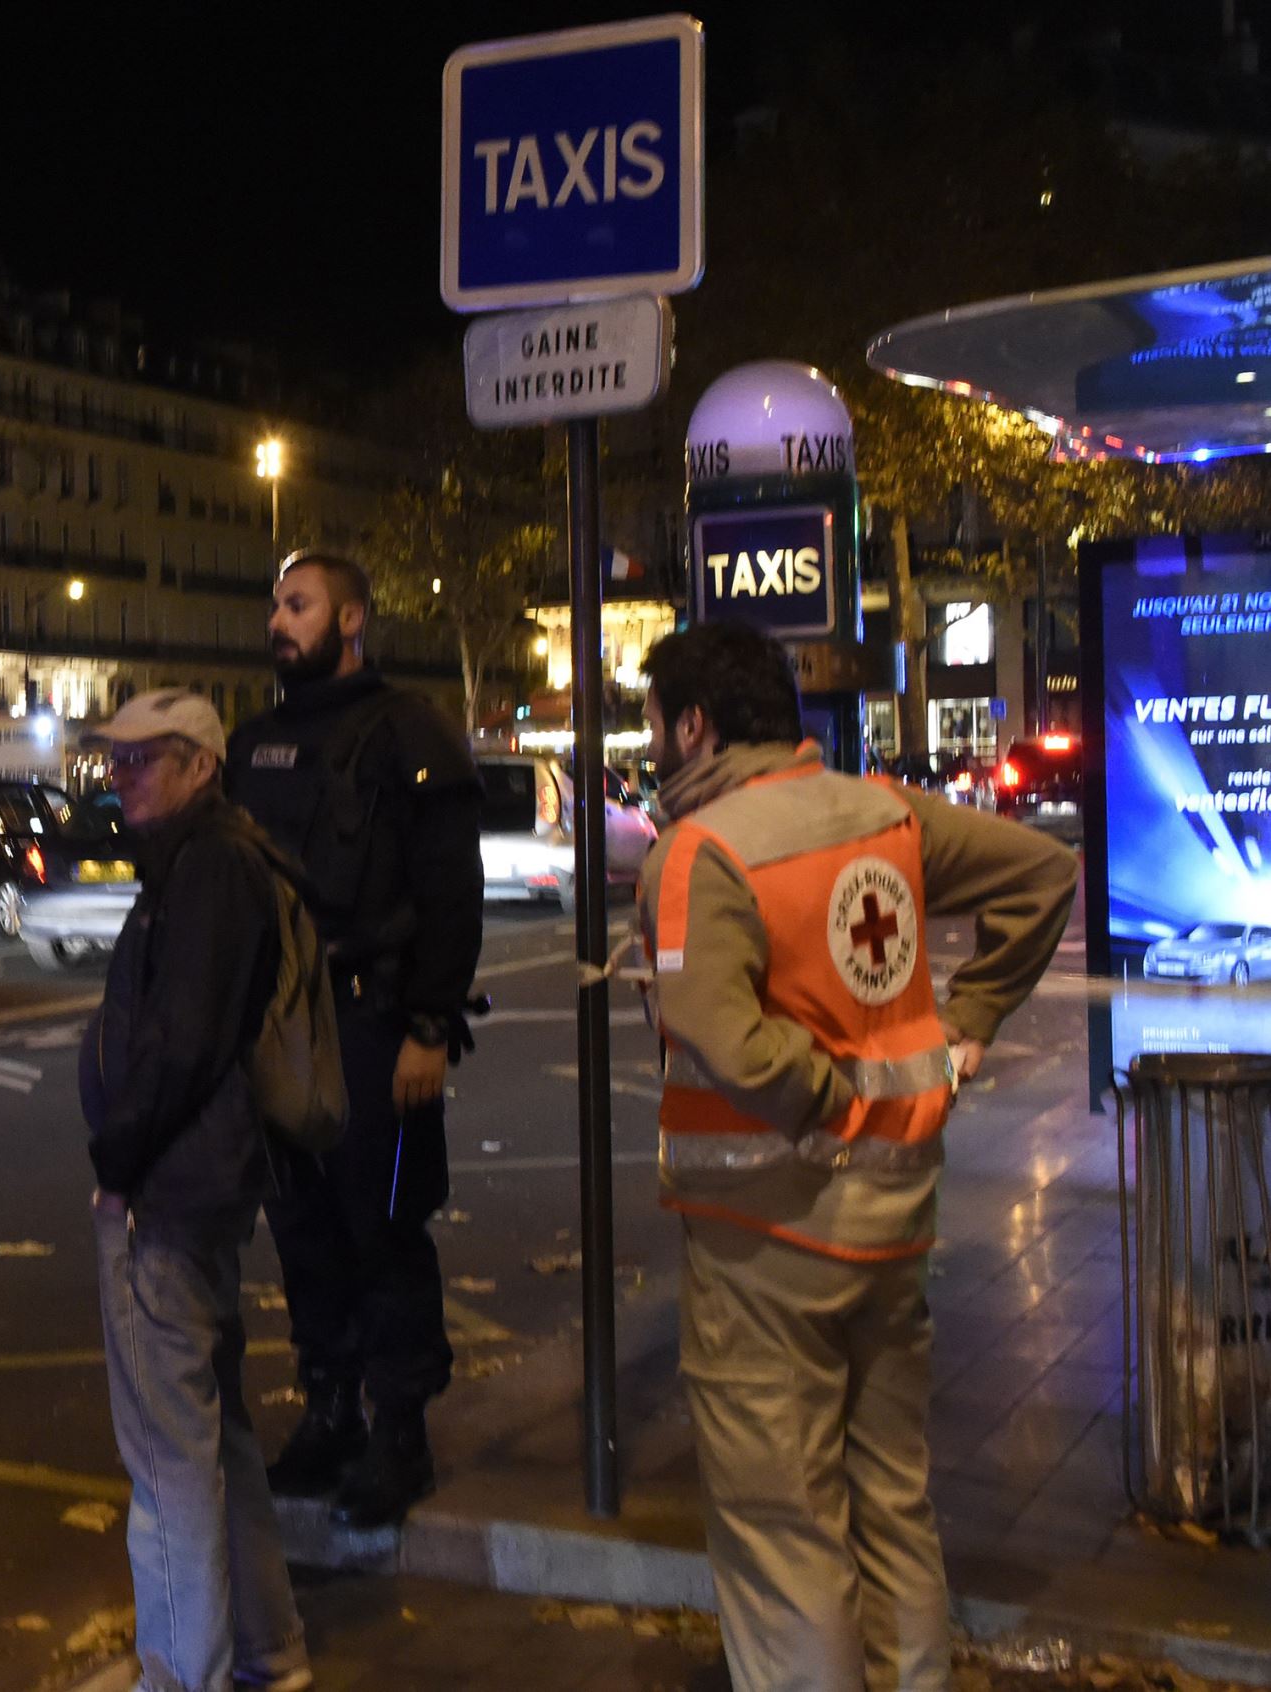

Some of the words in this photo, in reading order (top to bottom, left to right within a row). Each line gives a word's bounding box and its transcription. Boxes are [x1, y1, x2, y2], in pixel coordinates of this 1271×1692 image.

[474, 121, 665, 215] TAXIS
[521, 321, 598, 360] GAINE
[495, 360, 627, 406] INTERDITE
[781, 432, 849, 473] TAXIS
[707, 547, 821, 599] TAXIS
[1132, 594, 1217, 619] JUSQU'AU
[1135, 695, 1237, 724] VENTES
[1190, 729, 1215, 746] sur
[1218, 728, 1246, 745] une
